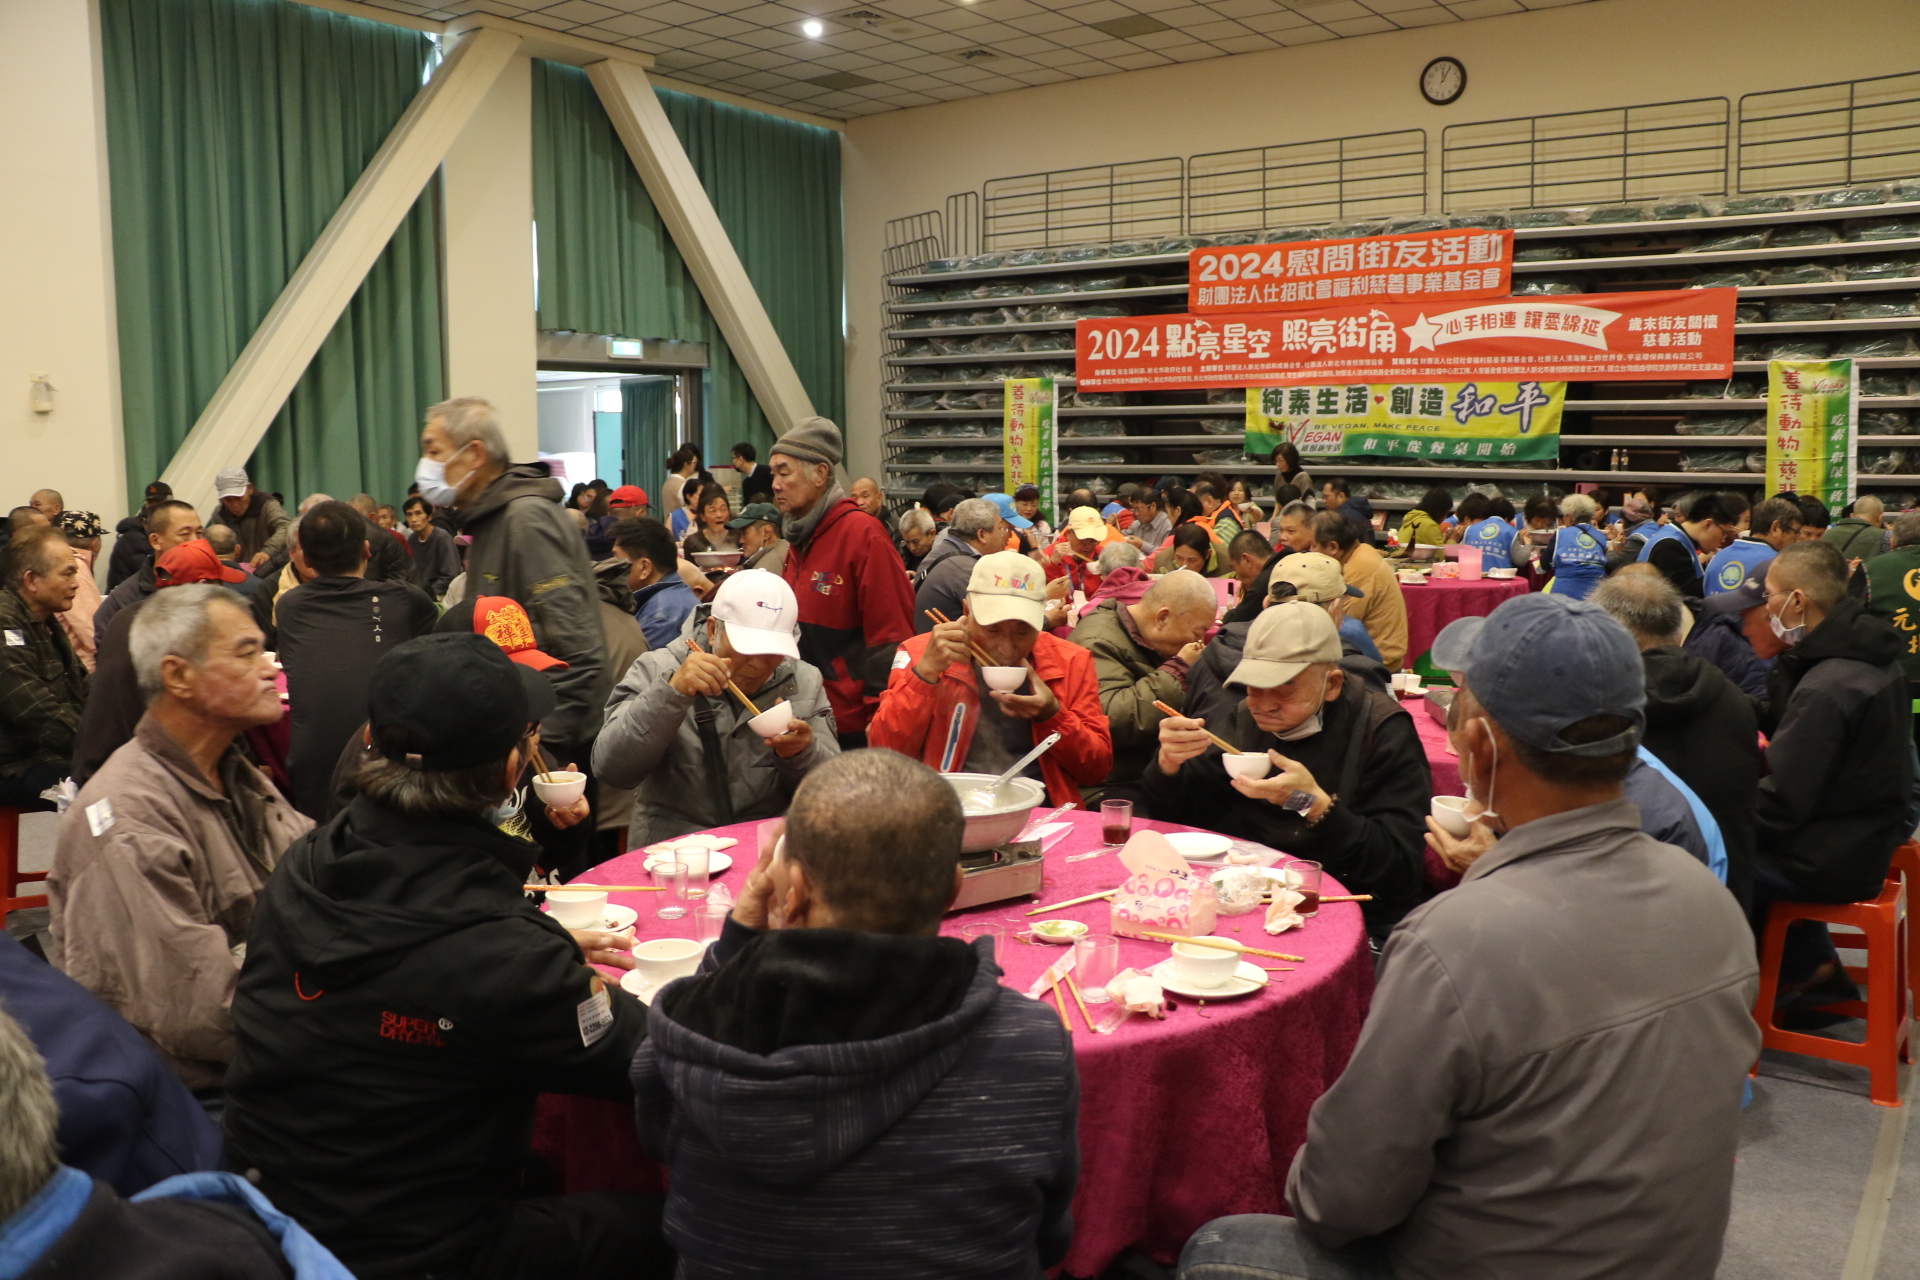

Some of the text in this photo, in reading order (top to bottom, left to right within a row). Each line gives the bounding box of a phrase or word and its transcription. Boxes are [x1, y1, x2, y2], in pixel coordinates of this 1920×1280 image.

[1198, 233, 1503, 282] 2024慰問街友活動
[1197, 267, 1501, 306] 財團法人仕招社會福利慈善事業基金會
[1446, 310, 1601, 337] 心手相連 讓愛綿延
[1628, 314, 1719, 332] 歲末街友關懷
[1087, 316, 1396, 361] 2024 點亮星空 照亮街角
[1642, 331, 1702, 347] 慈善活動
[1262, 385, 1368, 416] 純素生活
[1777, 369, 1803, 451] 善待動物
[1009, 384, 1025, 447] 善待動物
[1373, 422, 1402, 430] MAKE
[1406, 424, 1441, 432] PEACE
[1289, 418, 1343, 444] VEGAN
[1363, 437, 1517, 456] 和平從餐桌開始
[1892, 606, 1918, 631] 元
[382, 1010, 437, 1036] SUPER
